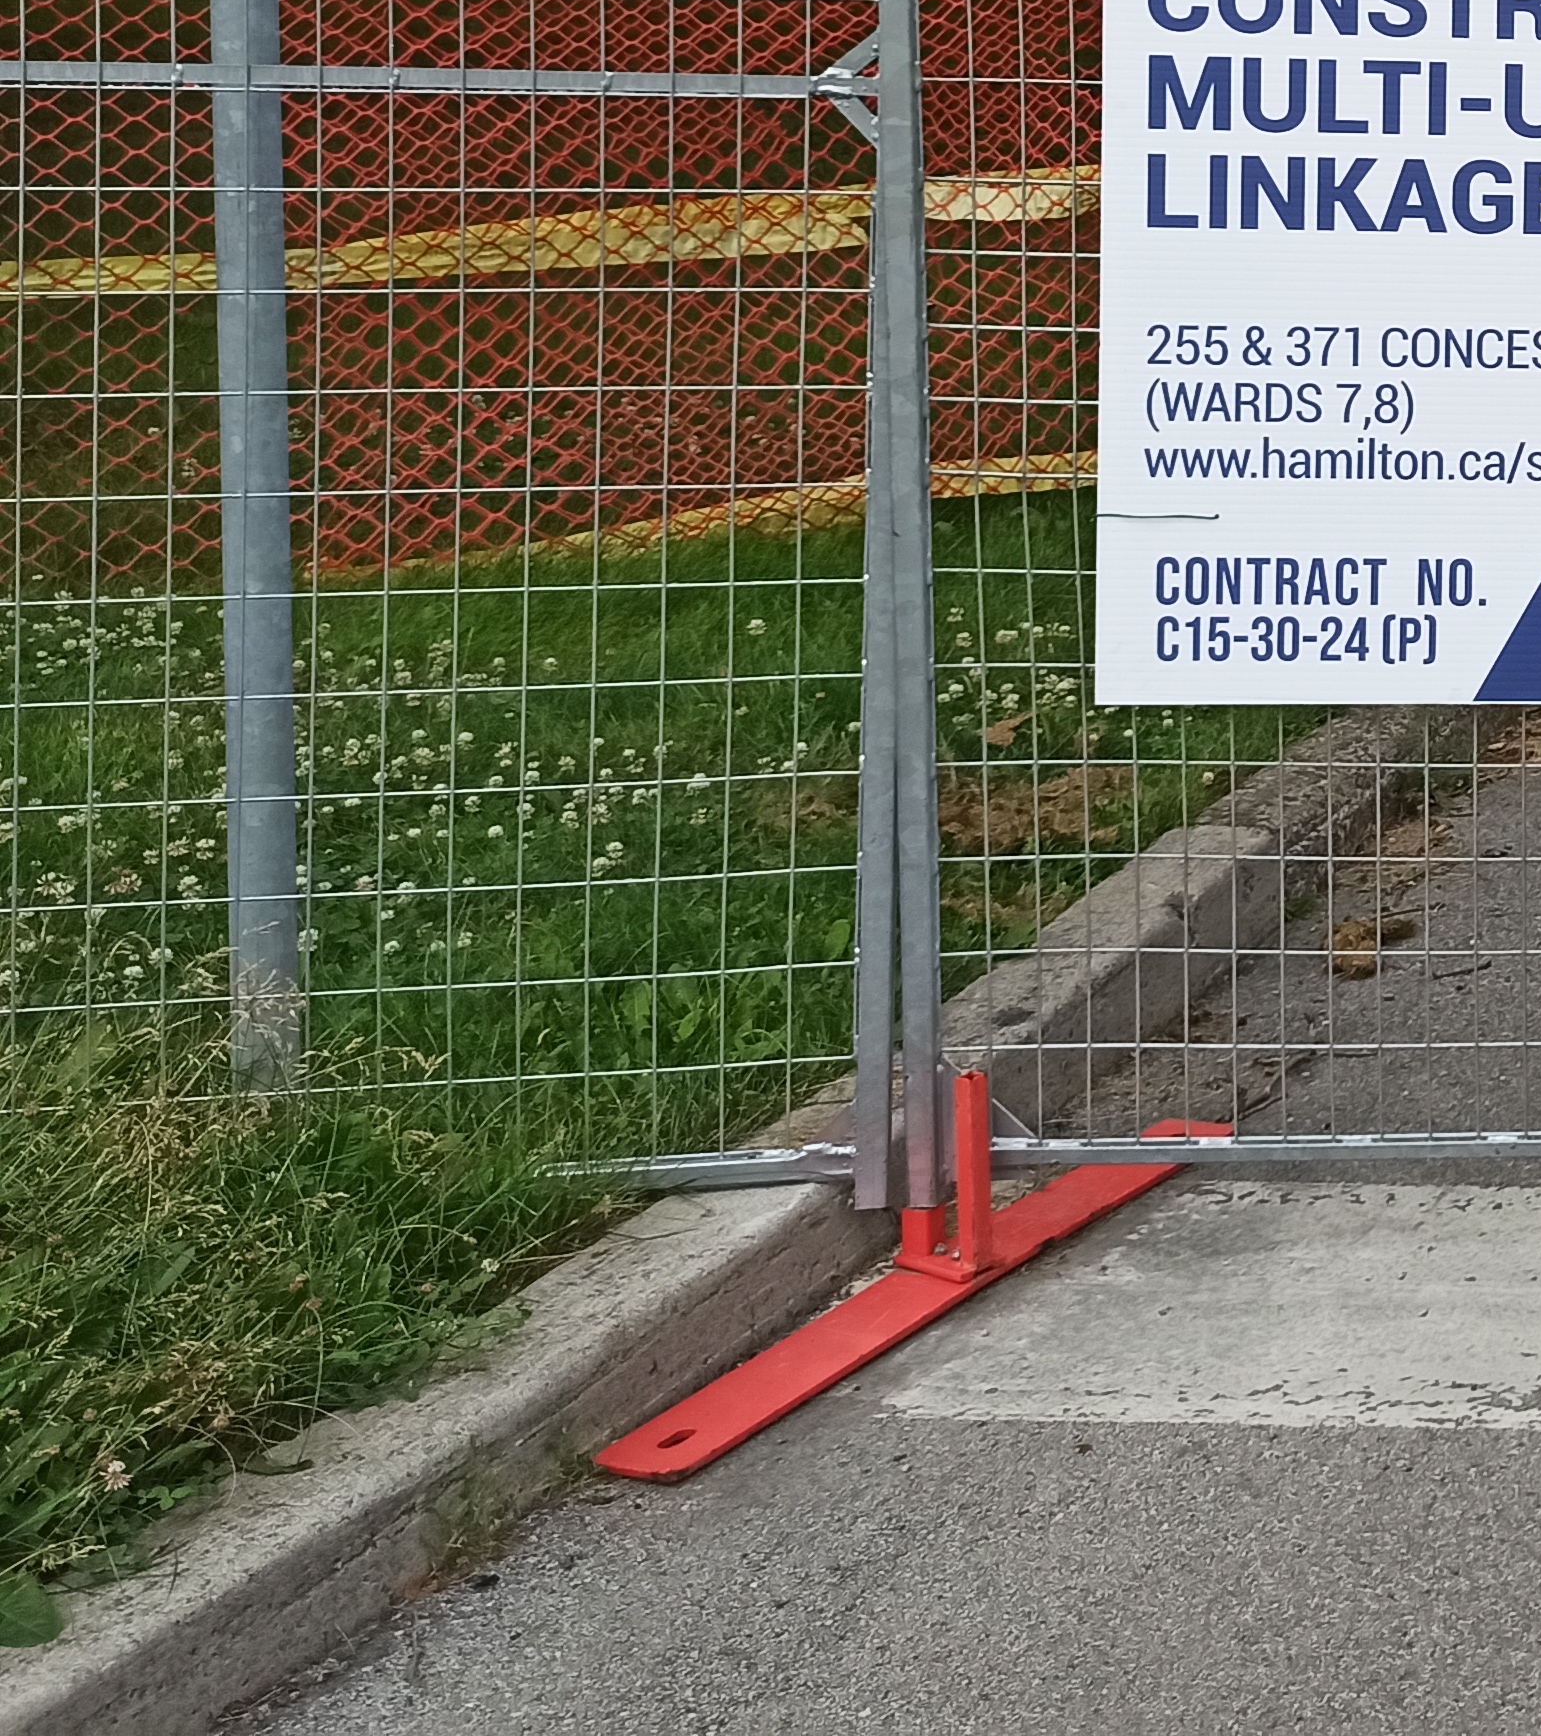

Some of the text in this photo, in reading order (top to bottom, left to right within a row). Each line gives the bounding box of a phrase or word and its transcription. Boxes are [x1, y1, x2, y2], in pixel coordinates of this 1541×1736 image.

[1147, 324, 1228, 365] 255
[1243, 325, 1271, 366] &
[1287, 327, 1359, 366] 371
[1147, 378, 1413, 434] (WARDS 7,8)
[1156, 557, 1486, 606] CONTRACT NO.
[1157, 615, 1436, 664] C15-30-24 (P)
